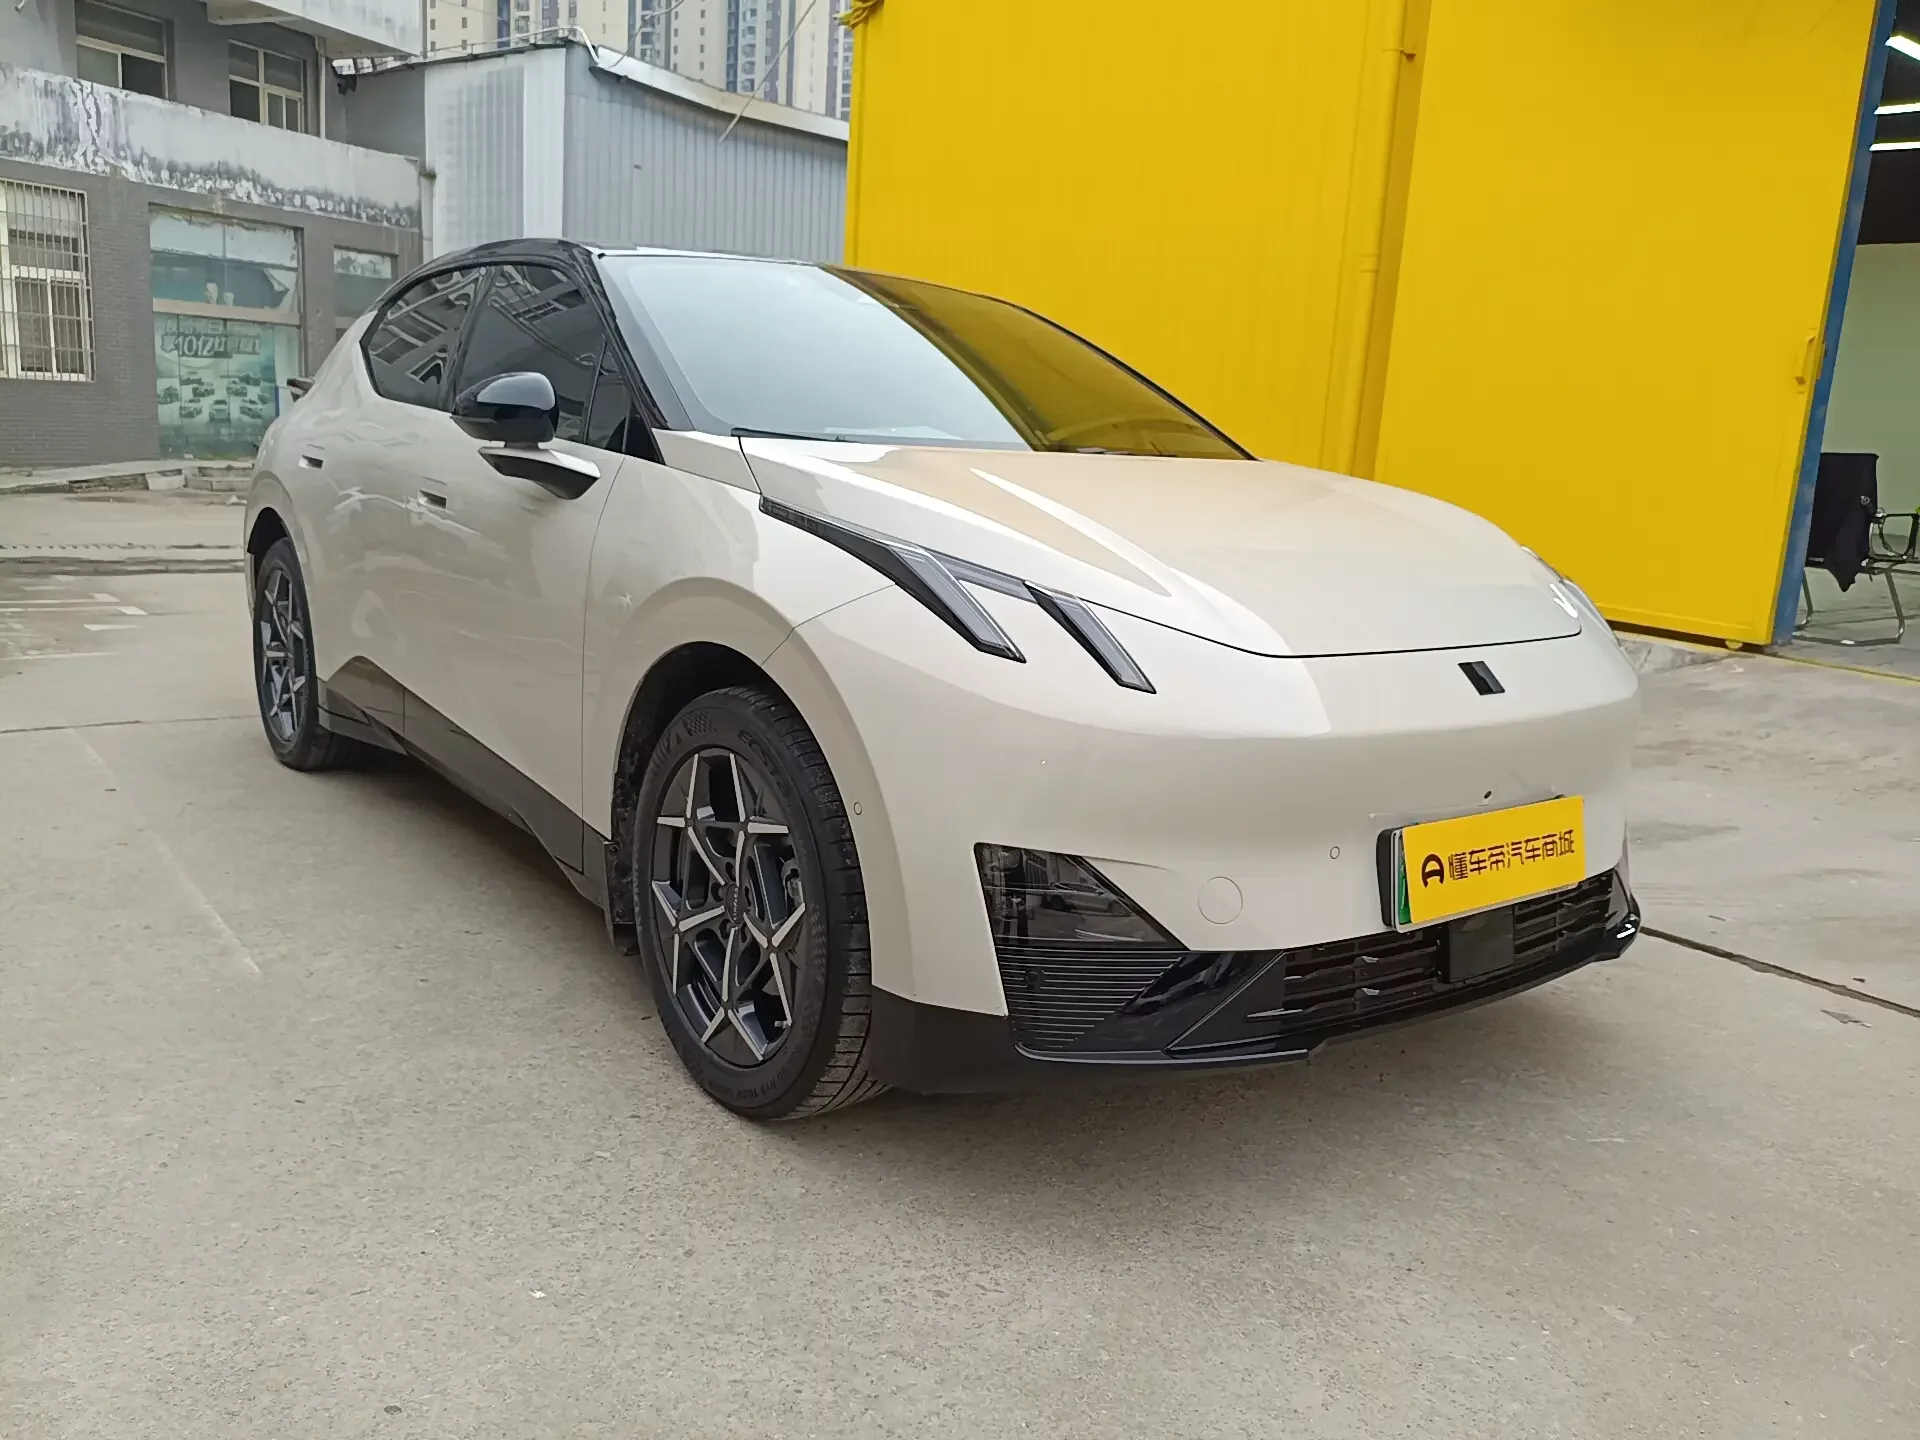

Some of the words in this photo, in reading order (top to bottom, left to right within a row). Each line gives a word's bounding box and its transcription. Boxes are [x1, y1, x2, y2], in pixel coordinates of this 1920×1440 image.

[1447, 829, 1575, 880] 懂车帝汽车商城
